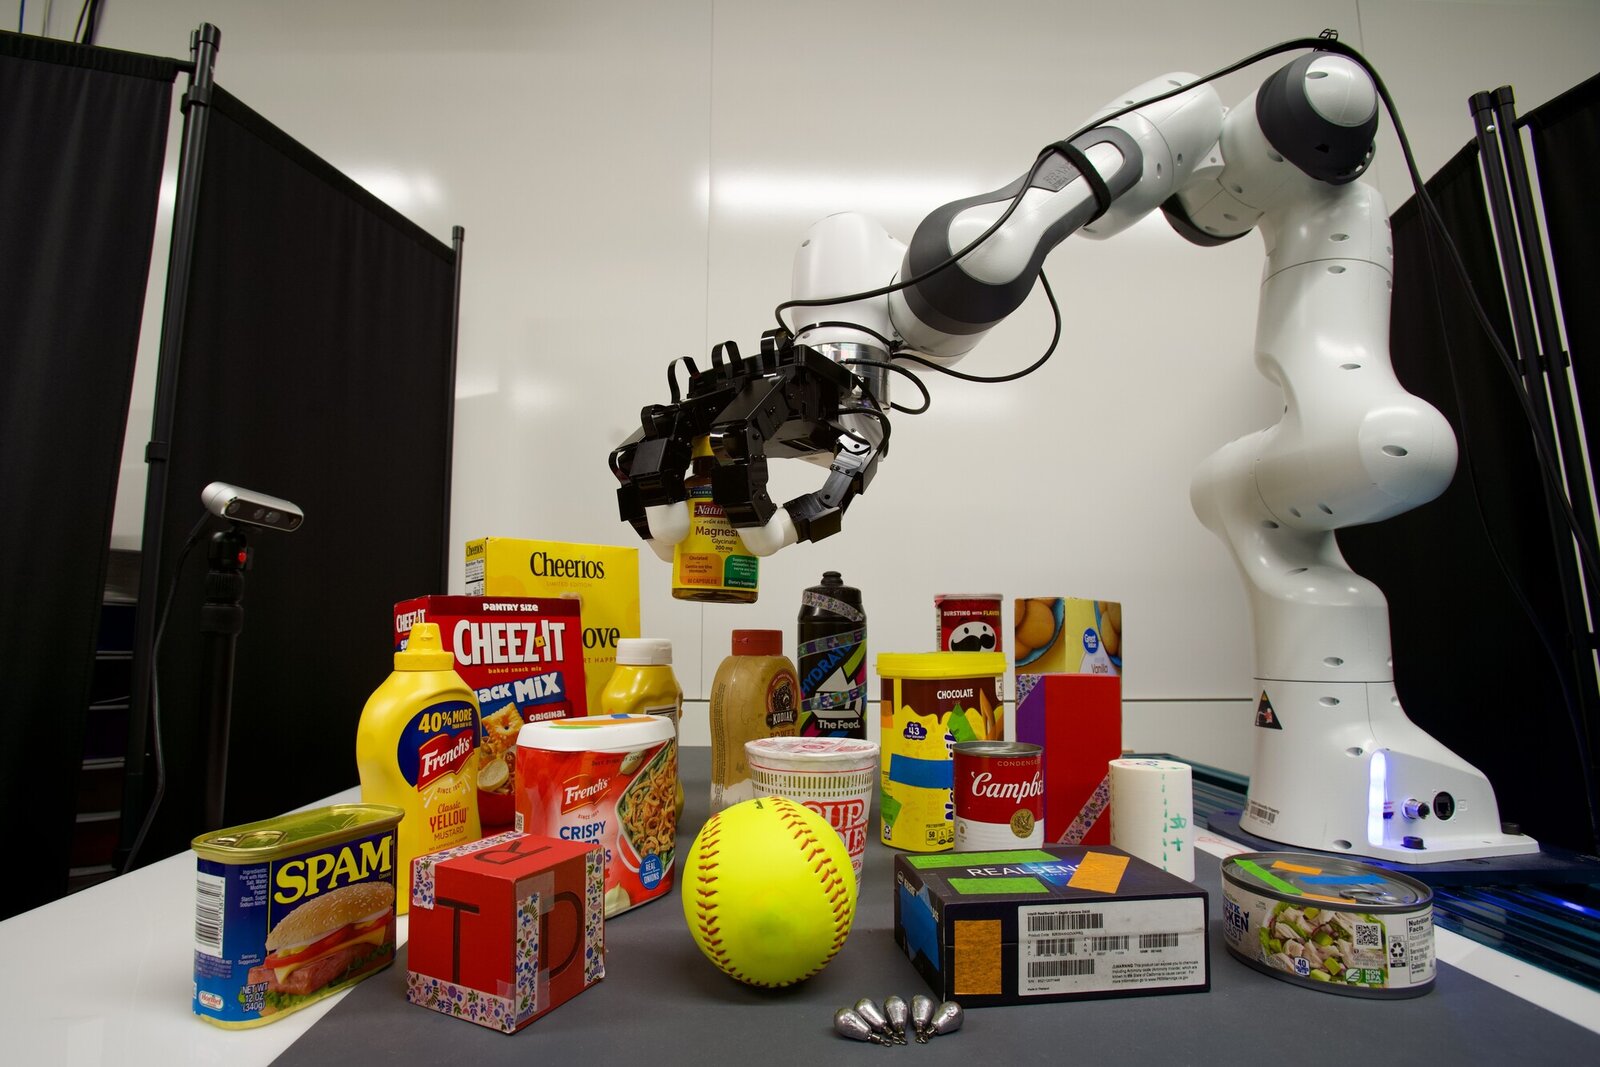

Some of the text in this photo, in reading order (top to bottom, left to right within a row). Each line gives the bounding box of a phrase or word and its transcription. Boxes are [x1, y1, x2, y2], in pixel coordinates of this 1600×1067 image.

[695, 526, 740, 538] Magnesi
[530, 552, 604, 579] Cheerios
[582, 628, 620, 649] ove
[1091, 663, 1109, 674] Vanilla
[936, 688, 974, 700] CHOCOLATE
[418, 708, 473, 734] 40% MORE
[772, 710, 794, 726] KODIAK
[818, 720, 837, 729] The
[908, 727, 920, 736] 43
[422, 738, 470, 778] French's
[565, 779, 608, 805] French's
[438, 800, 460, 814] Classic
[429, 807, 467, 833] YELLOW
[434, 826, 465, 841] MUSTARD
[559, 820, 606, 840] CRISPY
[928, 830, 936, 838] 50
[273, 835, 393, 905] SPAM
[1408, 917, 1429, 926] Nutrition
[1409, 925, 1424, 933] Facts
[435, 896, 480, 985] T
[1297, 959, 1306, 967] 40
[242, 982, 268, 994] NET WT
[245, 992, 263, 1002] 12 OZ
